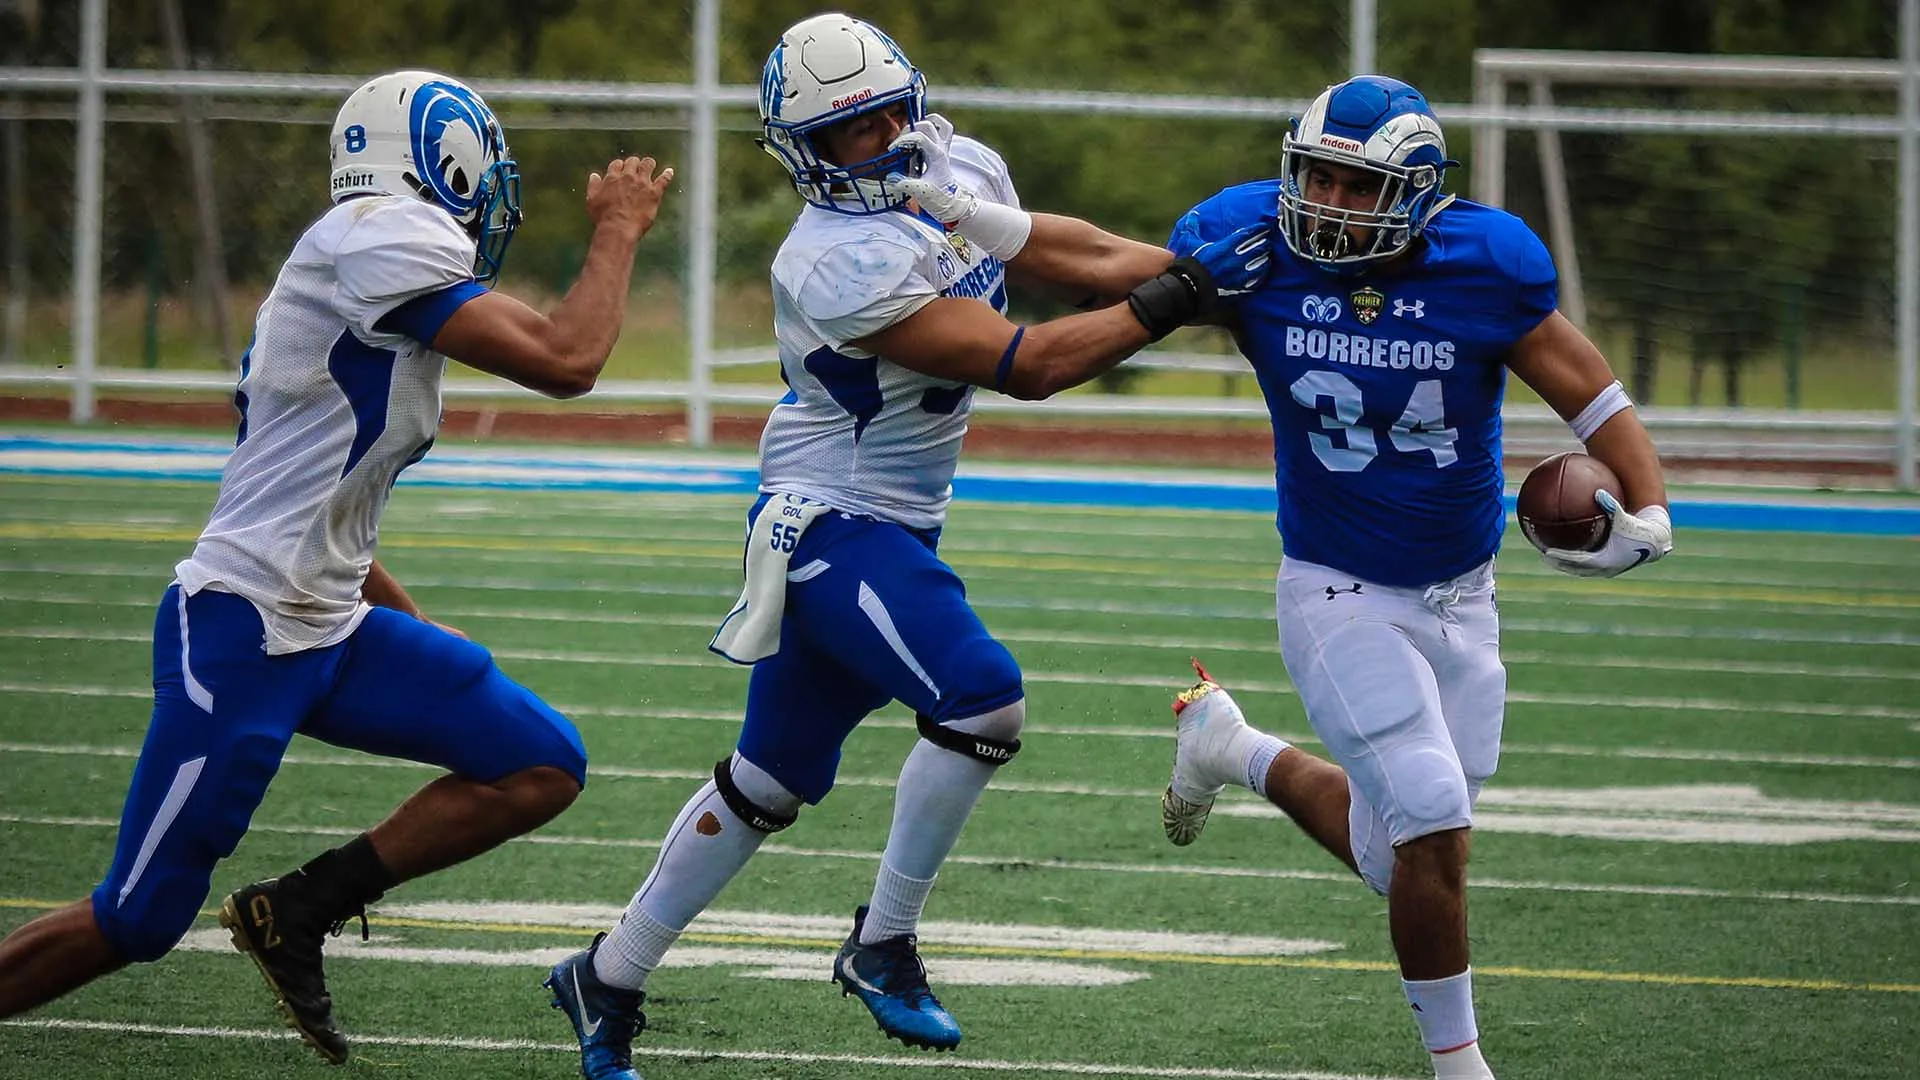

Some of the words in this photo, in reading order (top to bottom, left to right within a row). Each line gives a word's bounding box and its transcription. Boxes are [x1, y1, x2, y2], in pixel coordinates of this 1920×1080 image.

[832, 90, 872, 109] Riddell
[344, 124, 367, 154] 8
[1319, 137, 1360, 153] Riddell
[332, 172, 374, 190] schutt
[1353, 295, 1380, 306] PREMIER
[1285, 326, 1456, 371] BORREGOS
[1290, 369, 1459, 473] 34
[770, 522, 799, 553] 55
